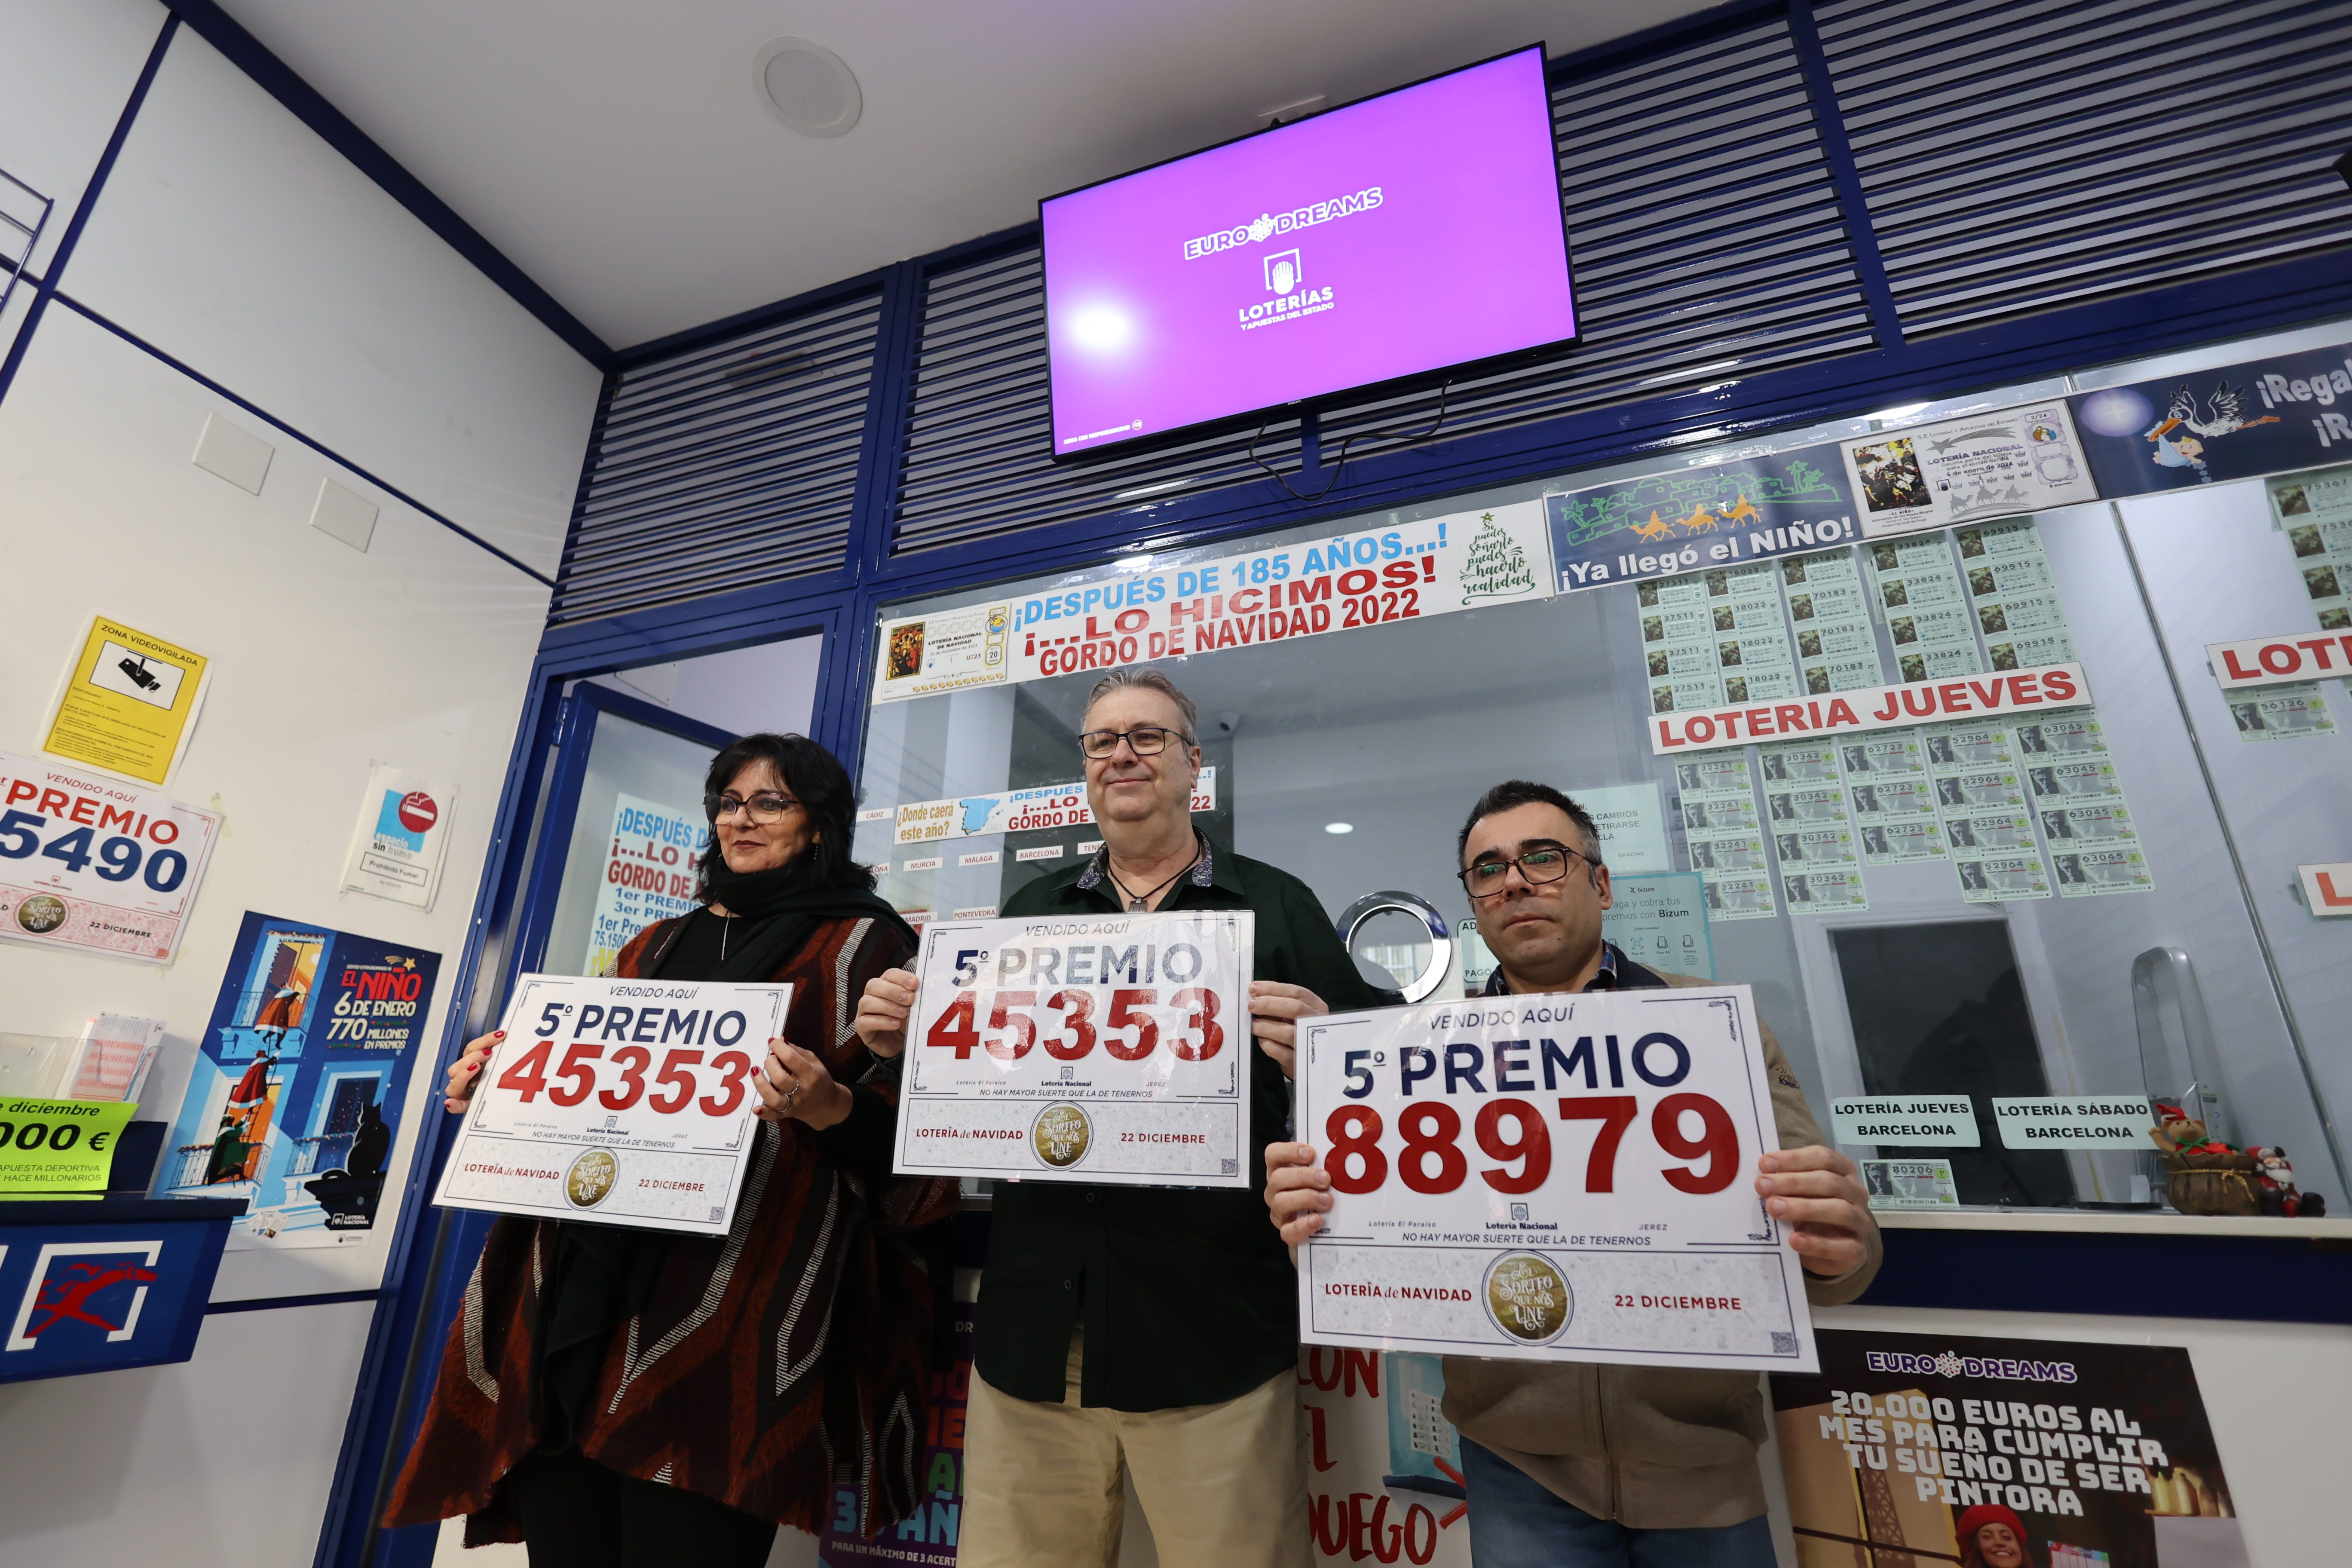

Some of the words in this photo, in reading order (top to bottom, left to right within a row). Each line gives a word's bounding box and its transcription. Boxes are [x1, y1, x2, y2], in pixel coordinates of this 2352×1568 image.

[1184, 226, 1249, 260] EURO
[1275, 187, 1384, 234] DREAMS
[1239, 286, 1333, 322] LOTERÍAS
[1247, 314, 1286, 329] APUESTAS
[1287, 310, 1302, 319] DEL
[1302, 302, 1334, 315] ESTADO
[1927, 453, 1971, 465] LOTERÍA
[1972, 444, 2023, 456] NACIONAL
[1482, 521, 1494, 531] Si
[1470, 535, 1515, 556] soñarlo
[1473, 528, 1507, 545] puedes
[1465, 548, 1506, 571] puedes
[1562, 559, 1614, 592] ¡Ya
[1617, 545, 1697, 579] llegó
[1710, 531, 1740, 561] el
[1752, 516, 1855, 552] NIÑO!
[1476, 557, 1527, 578] hacerlo
[1994, 561, 2031, 572] 69915
[1014, 575, 1166, 633] ¡DESPUÉS
[1177, 566, 1220, 598] DE
[1232, 554, 1290, 587] 185
[1302, 523, 1448, 576] AÑOS...!
[1463, 568, 1534, 594] realidad
[1907, 575, 1942, 585] 33824
[1170, 555, 1436, 627] HICIMOS!
[1813, 589, 1846, 598] 70183
[1735, 602, 1766, 611] 18022
[1664, 612, 1694, 621] 27511
[928, 637, 952, 645] LOTERÍA
[954, 632, 982, 640] NACIONAL
[1040, 634, 1137, 677] GORDO
[1149, 628, 1185, 658] DE
[1195, 603, 1331, 652] NAVIDAD
[1342, 588, 1420, 629] 2022
[101, 624, 128, 639] ZONA
[131, 635, 198, 666] VIDEOVIGILADA
[946, 640, 971, 648] NAVIDAD
[1658, 697, 1860, 747] LOTERIA
[1872, 671, 2077, 721] JUEVES
[2261, 699, 2304, 710] 56126
[2057, 765, 2096, 775] 63045
[46, 772, 103, 793] VENDIDO
[105, 790, 138, 803] AQUÍ
[1877, 784, 1912, 792] 62723
[1963, 775, 2001, 784] 52964
[1794, 793, 1827, 801] 30342
[5, 779, 179, 844] PREMIO
[866, 811, 884, 819] CÁDIZ
[897, 805, 928, 827] ¿Donde
[929, 801, 954, 819] caerá
[1597, 811, 1638, 820] CAMBIOS
[900, 825, 922, 841] este
[925, 820, 950, 838] año?
[376, 832, 409, 848] espacio
[0, 809, 187, 892] 5490
[373, 841, 386, 852] sin
[387, 845, 412, 860] humo
[965, 855, 993, 864] MÁLAGA
[1020, 848, 1059, 858] BARCELONA
[370, 860, 398, 873] Prohibido
[399, 869, 419, 878] Fumar
[911, 861, 936, 869] MURCIA
[1640, 898, 1663, 906] cobra
[954, 909, 995, 919] PONTEVEDRA
[1659, 909, 1689, 917] Bizum
[103, 923, 152, 938] DICIEMBRE
[1026, 924, 1090, 937] VENDIDO
[1092, 922, 1130, 935] AQUÍ
[951, 949, 989, 987] 5º
[997, 943, 1203, 986] PREMIO
[341, 971, 357, 986] EL
[355, 967, 422, 1001] NIÑO
[609, 986, 662, 998] VENDIDO
[666, 987, 699, 999] AQUÍ
[334, 991, 352, 1016] 6
[351, 1000, 372, 1016] DE
[372, 1001, 416, 1017] ENERO
[534, 1002, 573, 1038] 5º
[573, 1004, 747, 1047] PREMIO
[926, 988, 1224, 1062] 45353
[1430, 1011, 1516, 1030] VENDIDO
[1521, 1003, 1576, 1025] AQUÍ
[326, 1018, 368, 1040] 770
[367, 1029, 409, 1039] MILLONES
[364, 1041, 375, 1049] EN
[375, 1041, 406, 1049] PREMIOS
[1342, 1049, 1387, 1099] 5º
[1400, 1032, 1691, 1097] PREMIO
[497, 1040, 751, 1117] 45353
[9, 1102, 100, 1116] diciembre
[1834, 1103, 1903, 1115] LOTERÍA
[1907, 1103, 1969, 1115] JUEVES
[1997, 1103, 2072, 1116] LOTERÍA
[2077, 1102, 2148, 1116] SÁBADO
[1856, 1124, 1956, 1136] BARCELONA
[2025, 1126, 2134, 1139] BARCELONA
[1324, 1092, 1740, 1195] 88979
[1403, 1233, 1418, 1241] NO
[1420, 1233, 1441, 1242] HAY
[1443, 1234, 1480, 1243] MAYOR
[1482, 1234, 1523, 1243] SUERTE
[1527, 1234, 1550, 1245] QUE
[1553, 1235, 1568, 1244] LA
[1571, 1236, 1586, 1245] DE
[1589, 1236, 1651, 1246] TENERNOS
[1325, 1282, 1382, 1298] LOTERÍA
[1383, 1288, 1400, 1300] de
[1401, 1286, 1472, 1302] NAVIDAD
[1614, 1295, 1634, 1308] 22
[1641, 1295, 1742, 1311] DICIEMBRE
[1866, 1351, 1936, 1374] EURO
[1963, 1356, 2077, 1384] DREAMS
[1830, 1390, 1956, 1423] 20.000
[1962, 1398, 2080, 1432] EUROS
[2089, 1408, 2141, 1436] AL
[1819, 1415, 1885, 1443] MES
[1894, 1419, 1986, 1452] PARA
[1994, 1430, 2168, 1467] CUMPLIR
[1843, 1442, 1888, 1470] TU
[1895, 1446, 2013, 1482] SUEÑO
[2020, 1457, 2064, 1486] DE
[2076, 1465, 2152, 1494] SER
[1915, 1475, 2084, 1517] PINTORA
